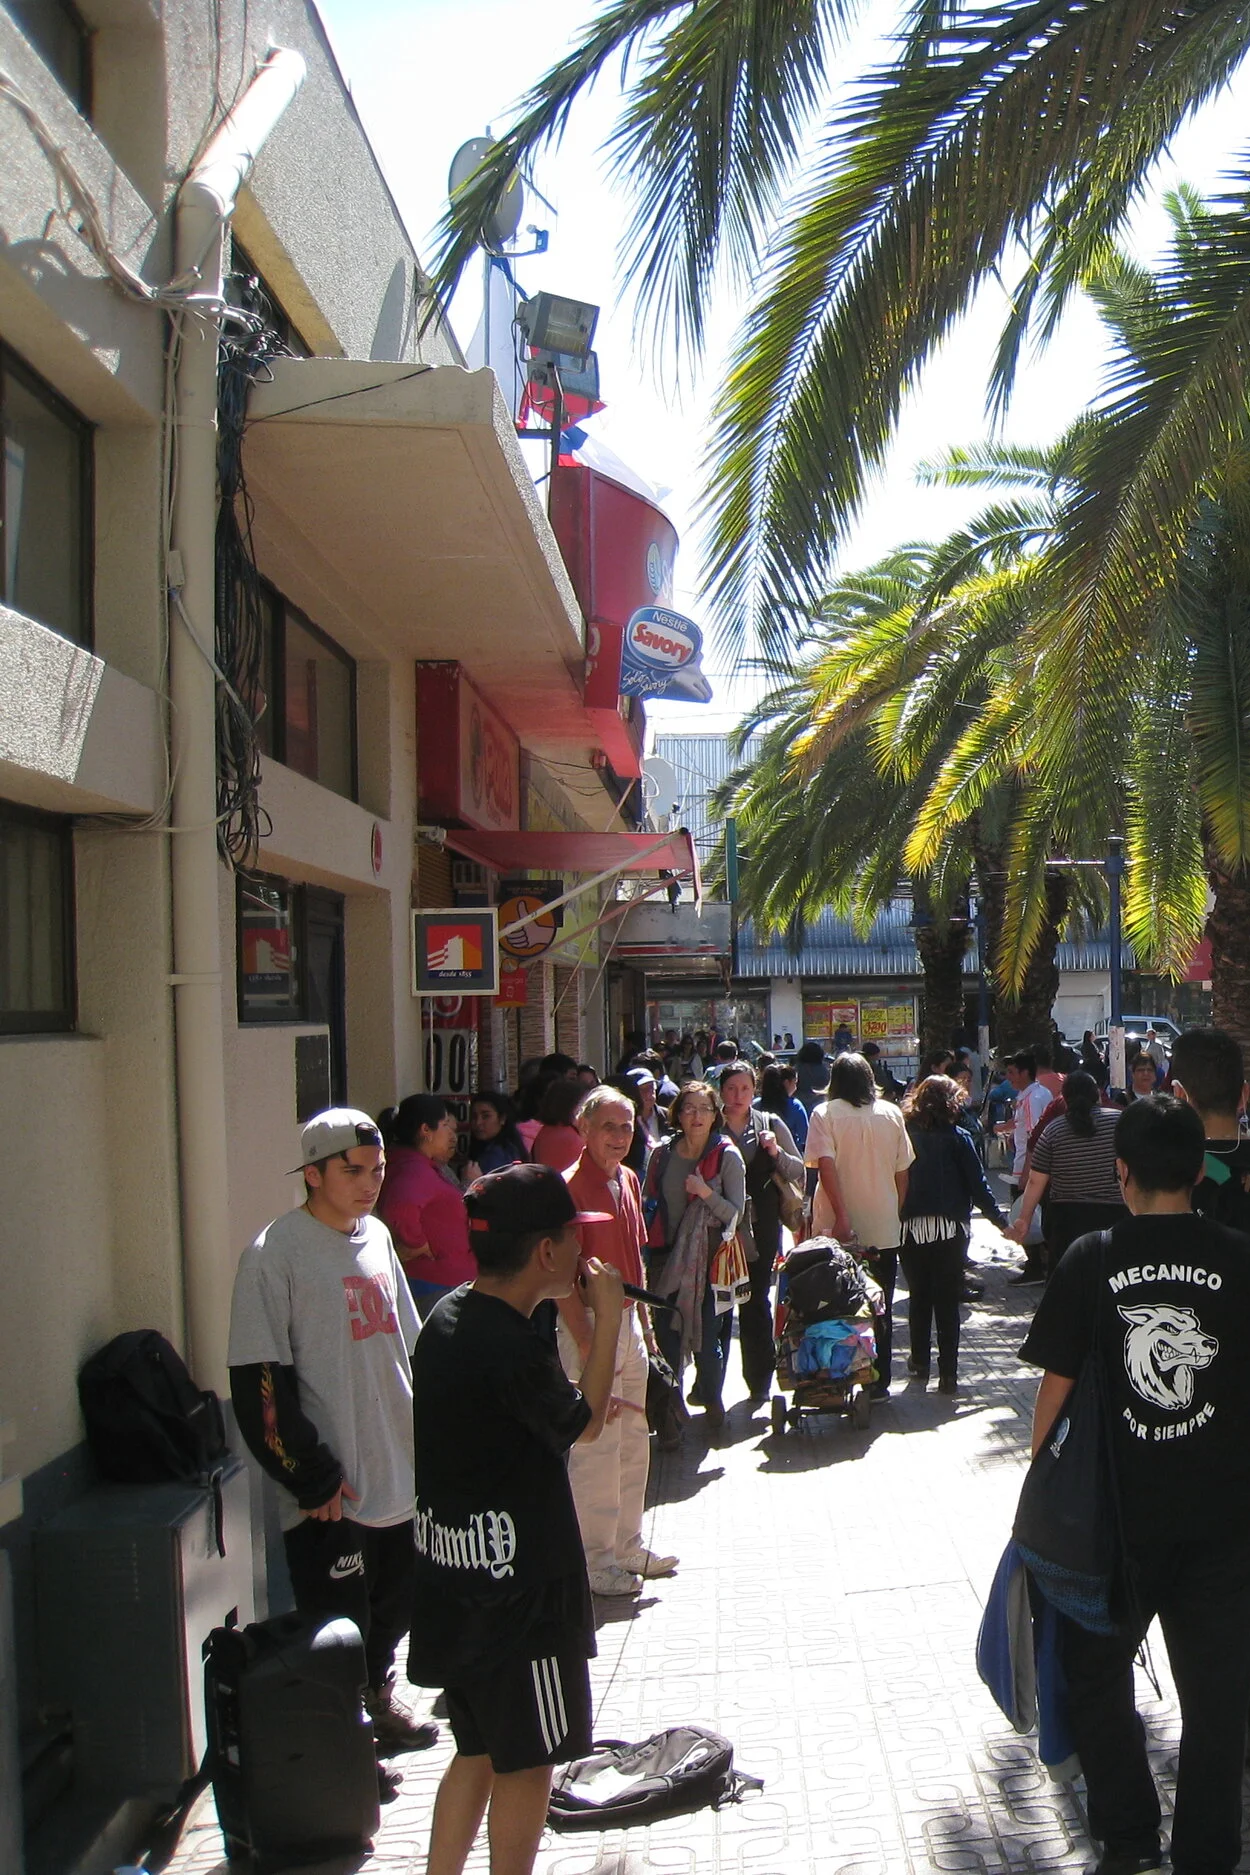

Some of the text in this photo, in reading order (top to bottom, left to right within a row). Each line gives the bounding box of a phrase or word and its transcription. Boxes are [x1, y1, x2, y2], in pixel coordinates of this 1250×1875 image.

[633, 623, 692, 663] Savory
[1108, 1263, 1223, 1294] MECANICO
[1121, 1401, 1217, 1441] POR SIEMPRE
